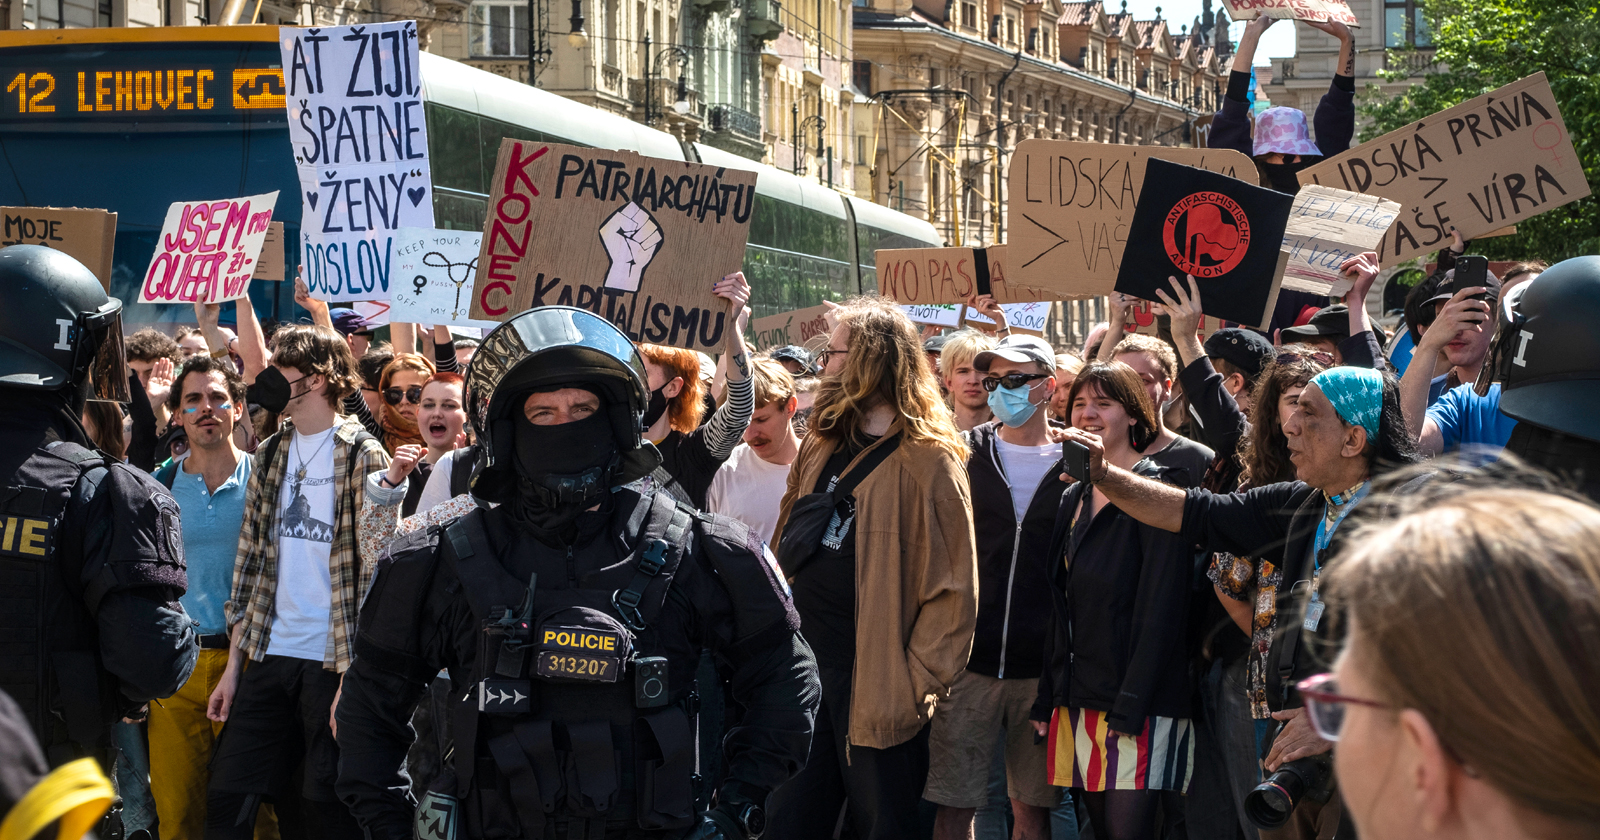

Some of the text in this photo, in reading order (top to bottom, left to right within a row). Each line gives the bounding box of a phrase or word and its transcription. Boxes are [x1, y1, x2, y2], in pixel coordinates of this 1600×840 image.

[290, 28, 329, 96] AŤ
[7, 69, 214, 113] 12 LEHOVEC
[1447, 91, 1553, 155] PRÁVA
[555, 154, 756, 224] PATRIARCHÁTU
[1026, 151, 1137, 210] LIDSKÁ
[1467, 164, 1568, 224] VÍRA
[5, 214, 63, 241] MOJE
[165, 200, 251, 253] JSEM
[247, 209, 272, 236] PRO
[480, 142, 549, 316] KONEC
[1167, 193, 1249, 245] ANTIFASCHISTISCHE
[397, 239, 425, 257] KEEP
[432, 237, 461, 246] YOUR
[1077, 216, 1127, 273] VAŠ
[1170, 253, 1223, 276] AKTION
[144, 252, 228, 302] QUEER
[224, 273, 251, 298] VOT
[430, 280, 453, 288] PUSSY
[882, 259, 919, 301] NO
[397, 293, 417, 307] OFF
[430, 307, 446, 315] MY
[1011, 311, 1045, 329] SLOVO
[543, 630, 616, 651] POLICIE
[548, 655, 609, 676] 313207
